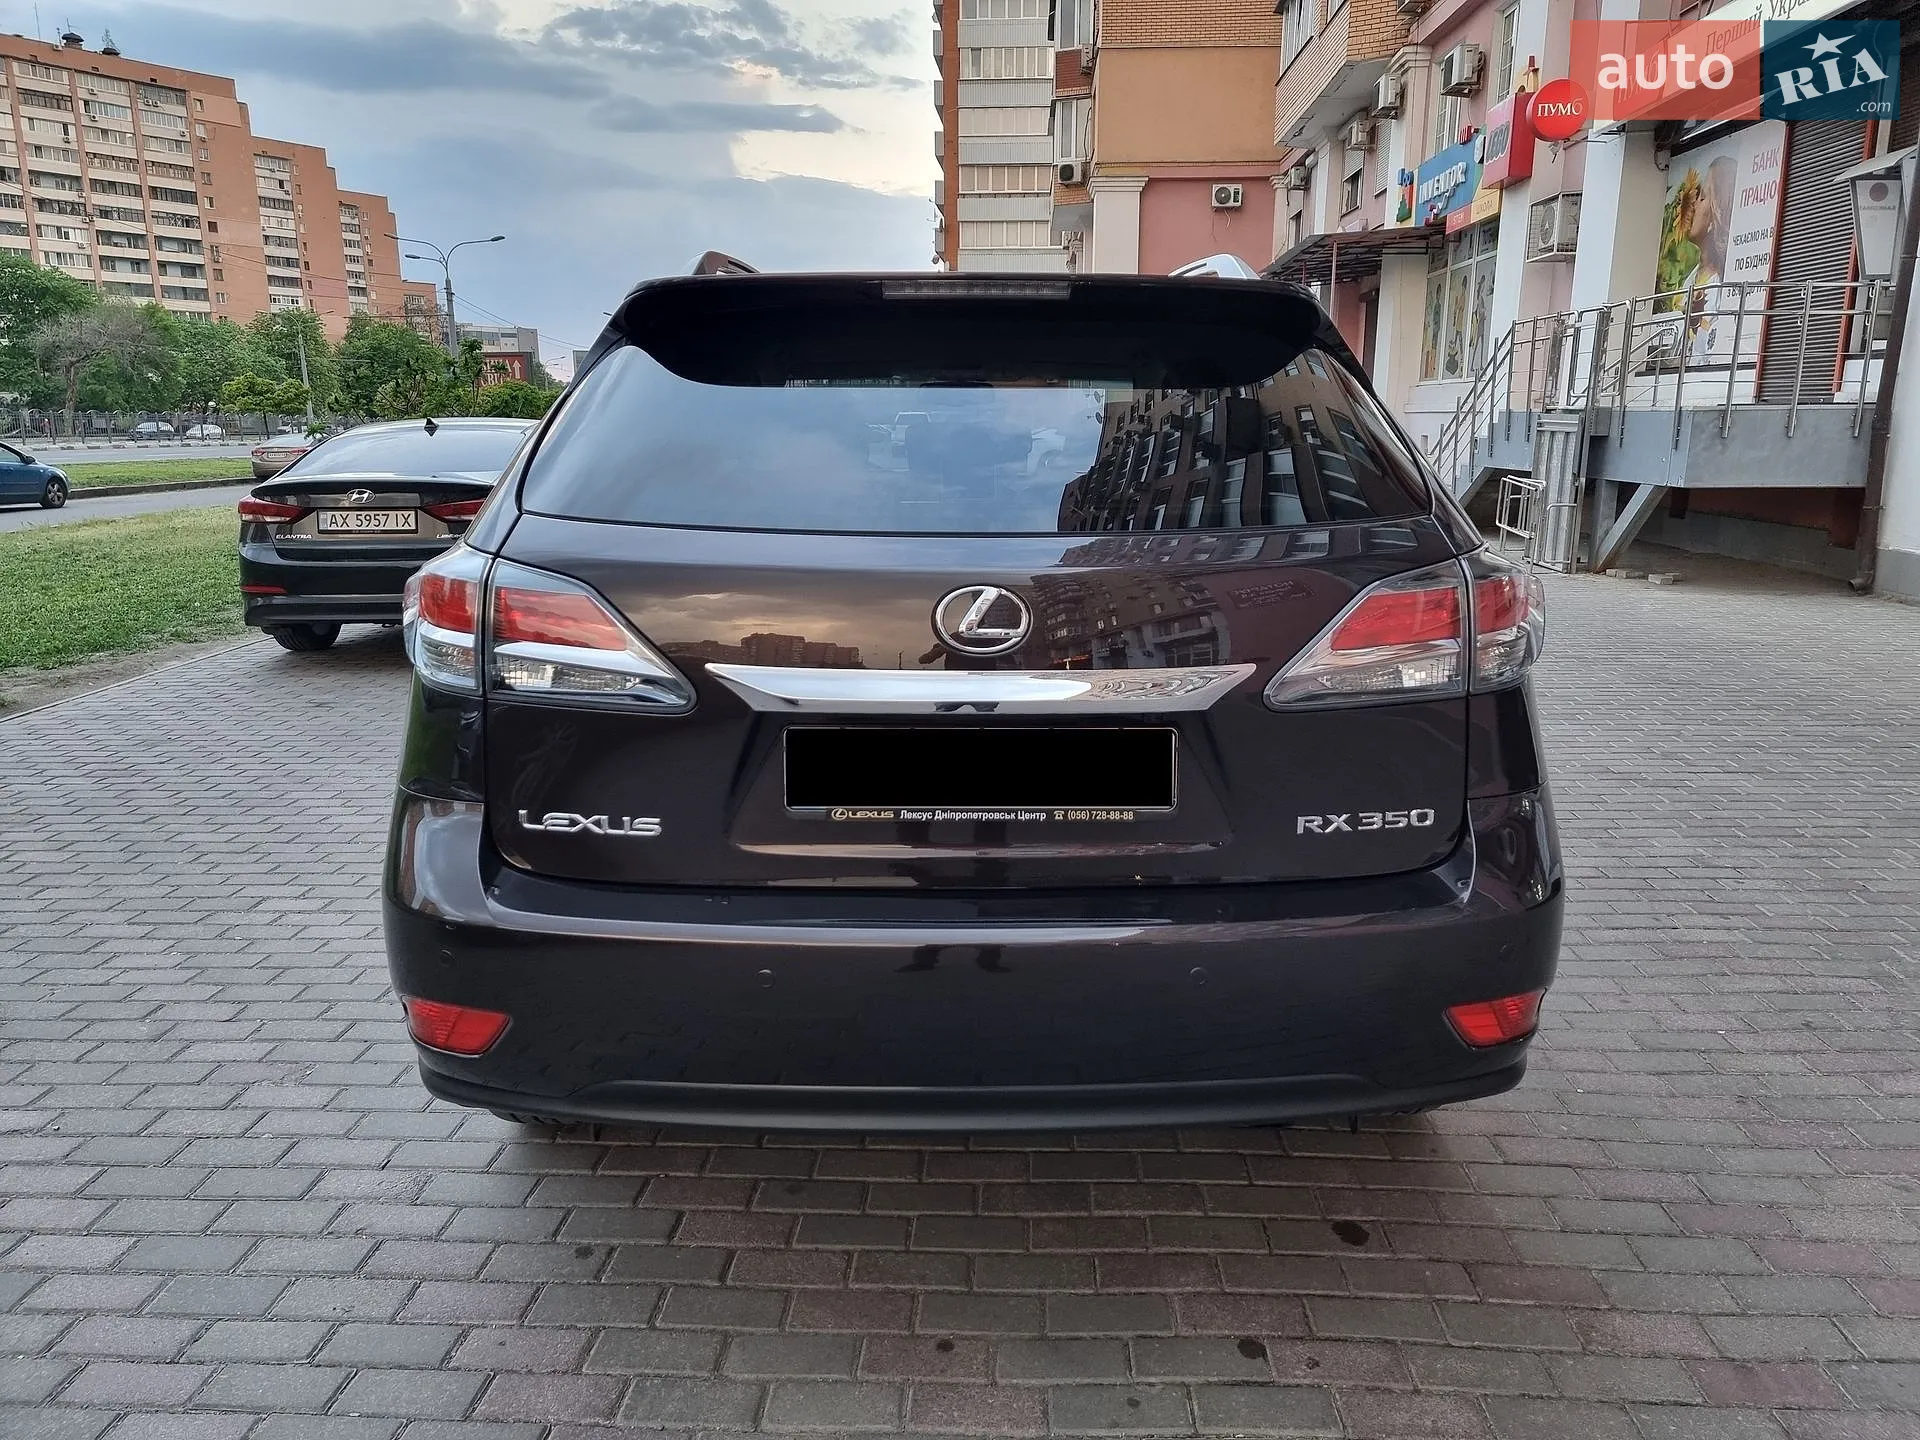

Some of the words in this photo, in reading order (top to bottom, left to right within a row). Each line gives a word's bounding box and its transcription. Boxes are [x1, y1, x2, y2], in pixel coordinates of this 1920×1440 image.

[1769, 0, 1810, 21] Укр
[1752, 147, 1780, 174] БАНК
[1419, 162, 1467, 204] INVENTOR
[1735, 258, 1745, 271] ПО
[329, 514, 350, 528] AX
[355, 513, 389, 528] 5957
[395, 513, 412, 528] IX
[518, 809, 662, 836] LEXUS
[848, 810, 894, 818] LEXUS
[900, 810, 933, 821] Лексус
[934, 810, 1016, 821] Дніпропетровськ
[1018, 810, 1047, 821] Центр
[1067, 810, 1090, 821] (056)
[1091, 810, 1134, 821] 728-88-88
[1296, 813, 1353, 834] RX
[1357, 808, 1435, 831] 350
